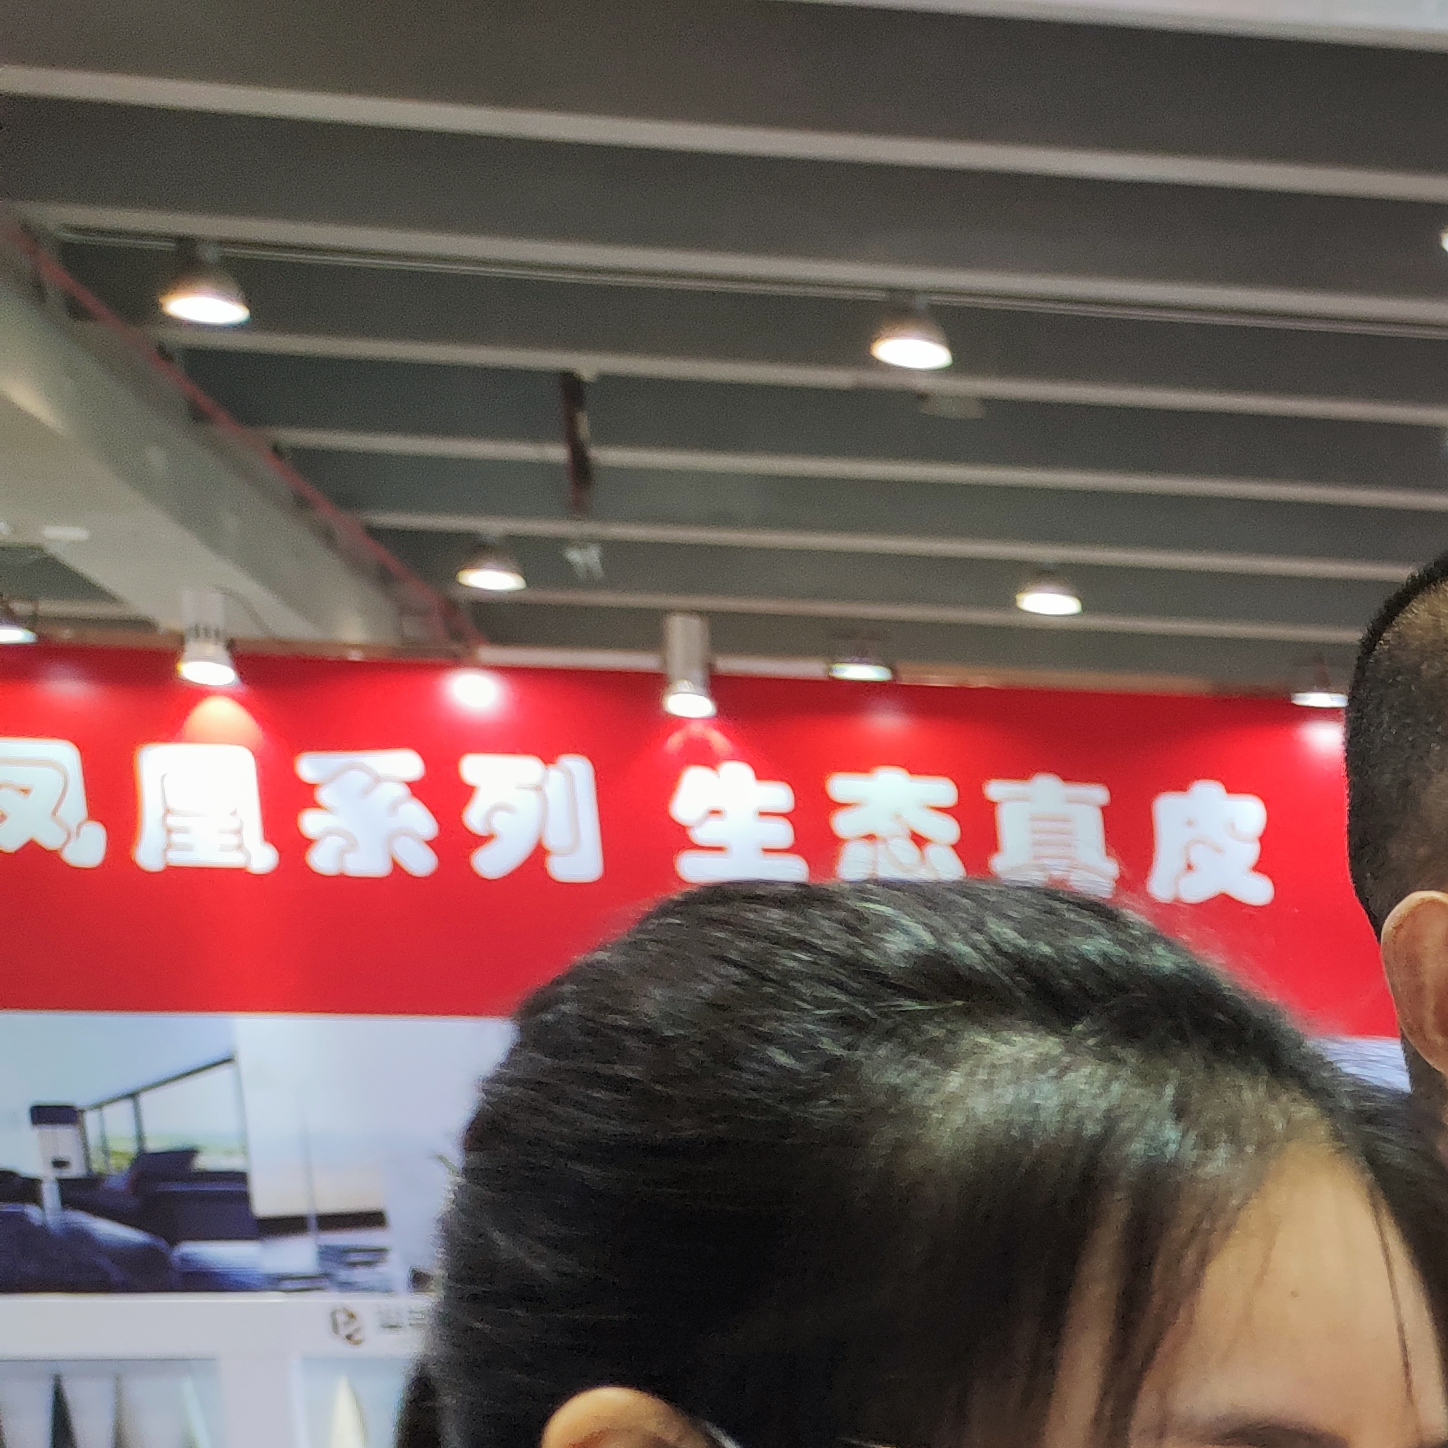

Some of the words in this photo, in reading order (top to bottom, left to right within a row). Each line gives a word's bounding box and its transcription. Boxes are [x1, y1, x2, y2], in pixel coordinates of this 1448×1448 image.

[0, 736, 605, 883] 凤凰系列
[670, 760, 1274, 907] 生态真皮
